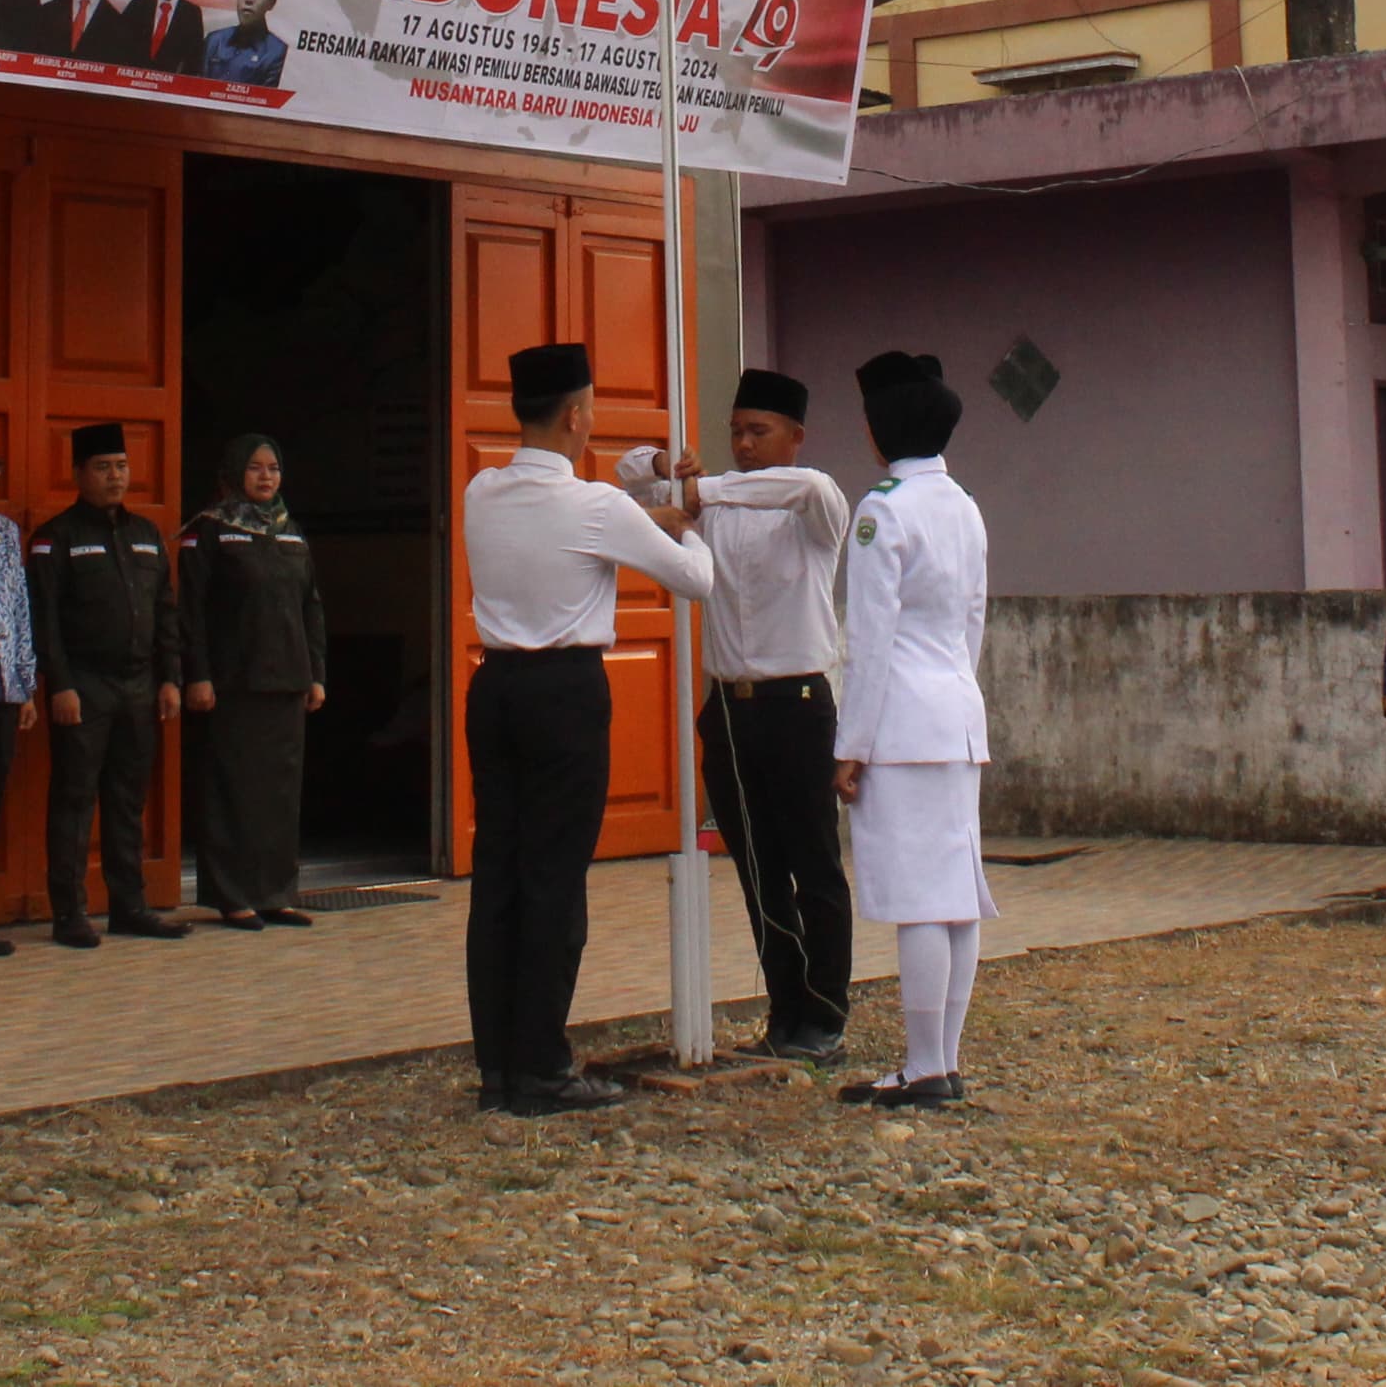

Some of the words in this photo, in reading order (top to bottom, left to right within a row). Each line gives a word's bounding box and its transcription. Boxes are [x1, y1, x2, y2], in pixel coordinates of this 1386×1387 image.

[296, 29, 366, 60] BERSAMA
[368, 40, 426, 69] RAKYAT
[426, 49, 471, 75] AWASI
[474, 55, 522, 81] PEMILU
[522, 62, 581, 91] BERSAMA
[583, 69, 640, 98] BAWASLU
[694, 88, 746, 114] KEADILAN
[747, 94, 785, 117] PEMILU
[402, 14, 422, 36] 17
[426, 18, 516, 51] AGUSTUS
[522, 33, 561, 57] 1945
[579, 42, 597, 63] 17
[600, 45, 662, 74] AGUST
[681, 57, 718, 81] 2024
[409, 76, 517, 112] NUSANTARA
[521, 92, 567, 118] BARU
[570, 97, 654, 128] INDONESIA
